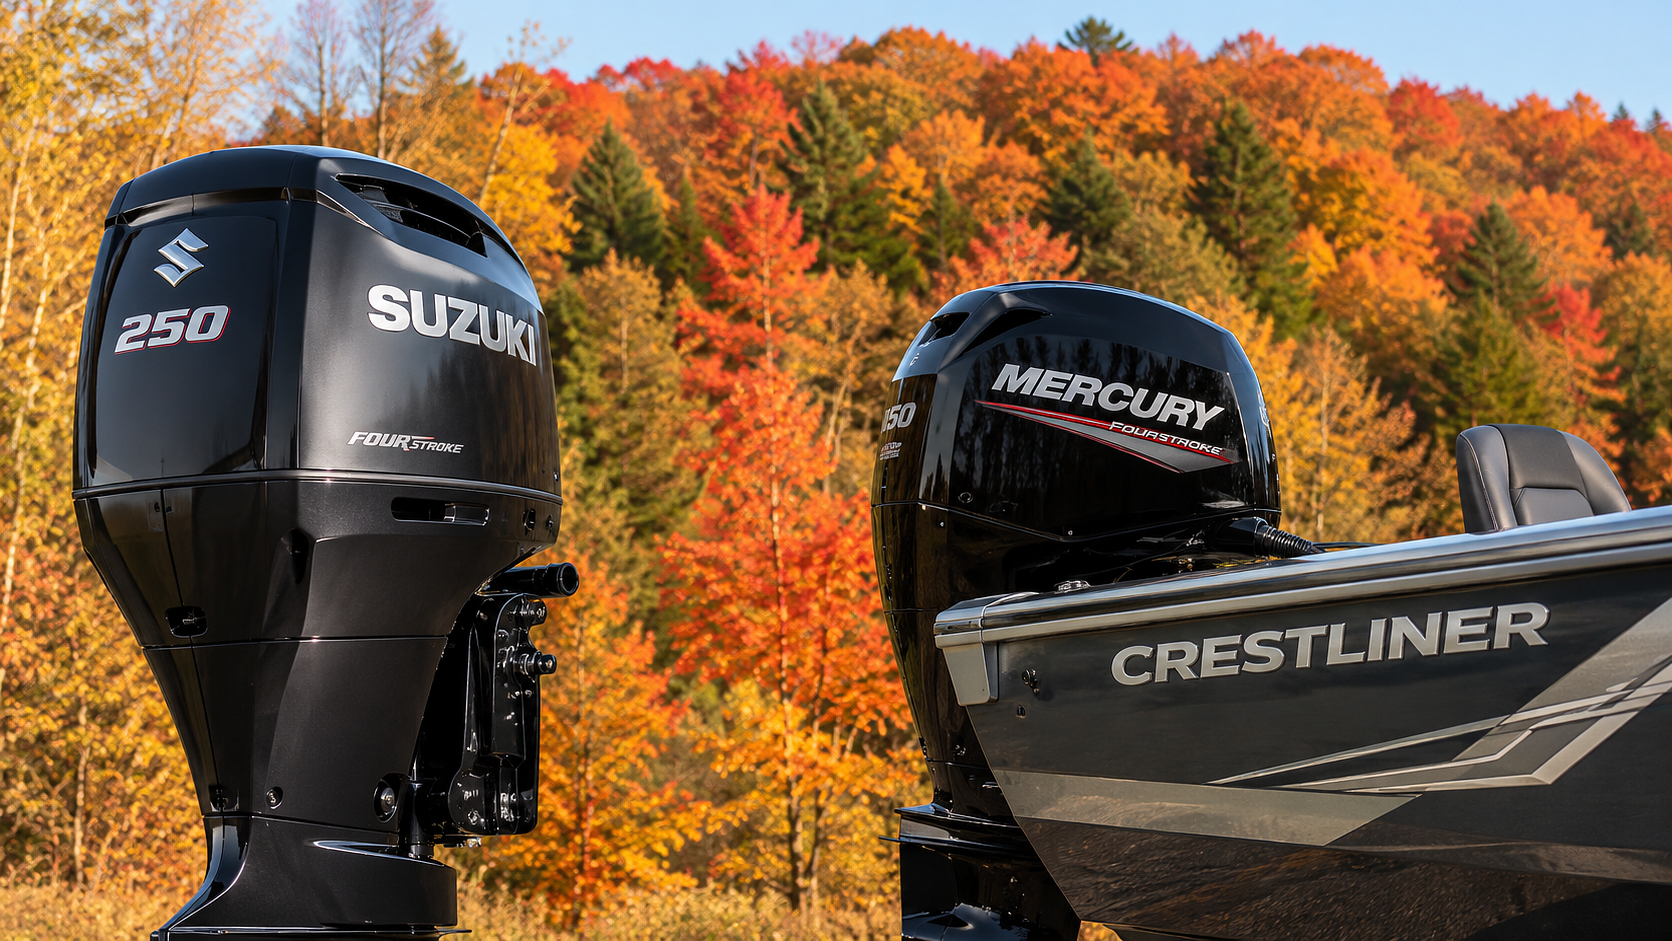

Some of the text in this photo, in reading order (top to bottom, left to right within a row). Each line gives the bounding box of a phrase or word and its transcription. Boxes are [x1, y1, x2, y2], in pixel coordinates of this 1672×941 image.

[114, 305, 231, 355] 250
[367, 284, 537, 366] SUZUKI
[991, 363, 1225, 430] MERCURY
[1109, 421, 1222, 455] FOURSTROKE
[1111, 602, 1550, 686] CRESTLINER
